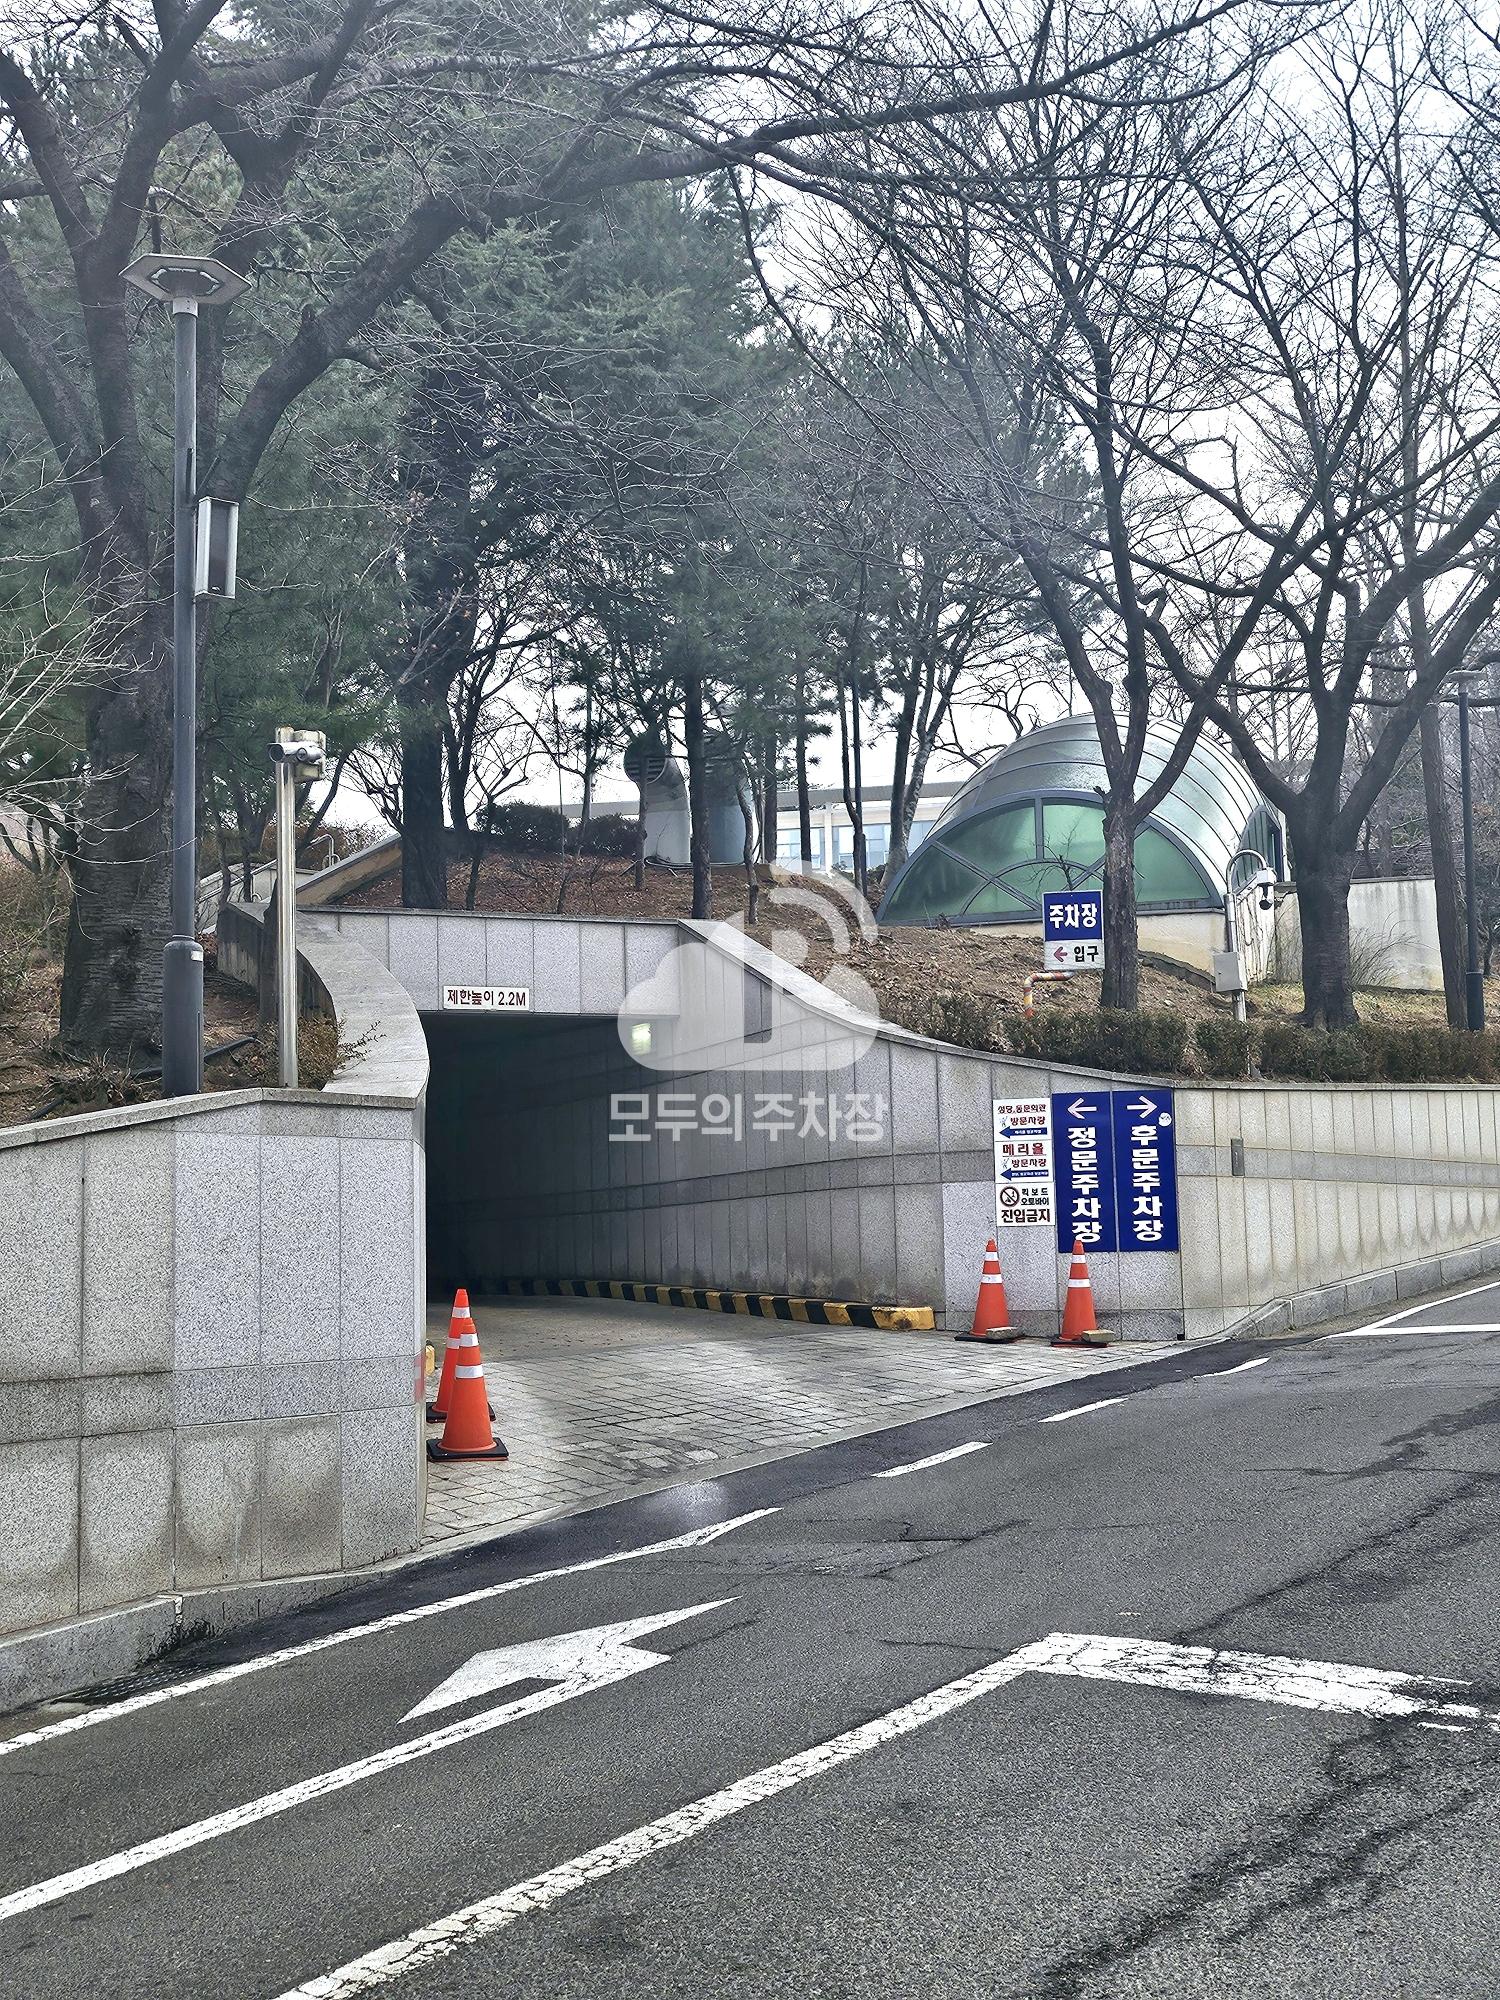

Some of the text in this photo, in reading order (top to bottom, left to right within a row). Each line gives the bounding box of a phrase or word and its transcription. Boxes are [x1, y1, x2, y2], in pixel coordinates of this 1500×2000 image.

[1049, 903, 1098, 929] 주차장
[1073, 945, 1099, 963] 입구
[447, 989, 526, 1006] 제한높이 2.2M
[1067, 1126, 1103, 1243] 정문주차장
[1130, 1125, 1164, 1242] 후문주차장
[1020, 1197, 1050, 1206] 오토바이
[1001, 1208, 1051, 1223] 진입금지
